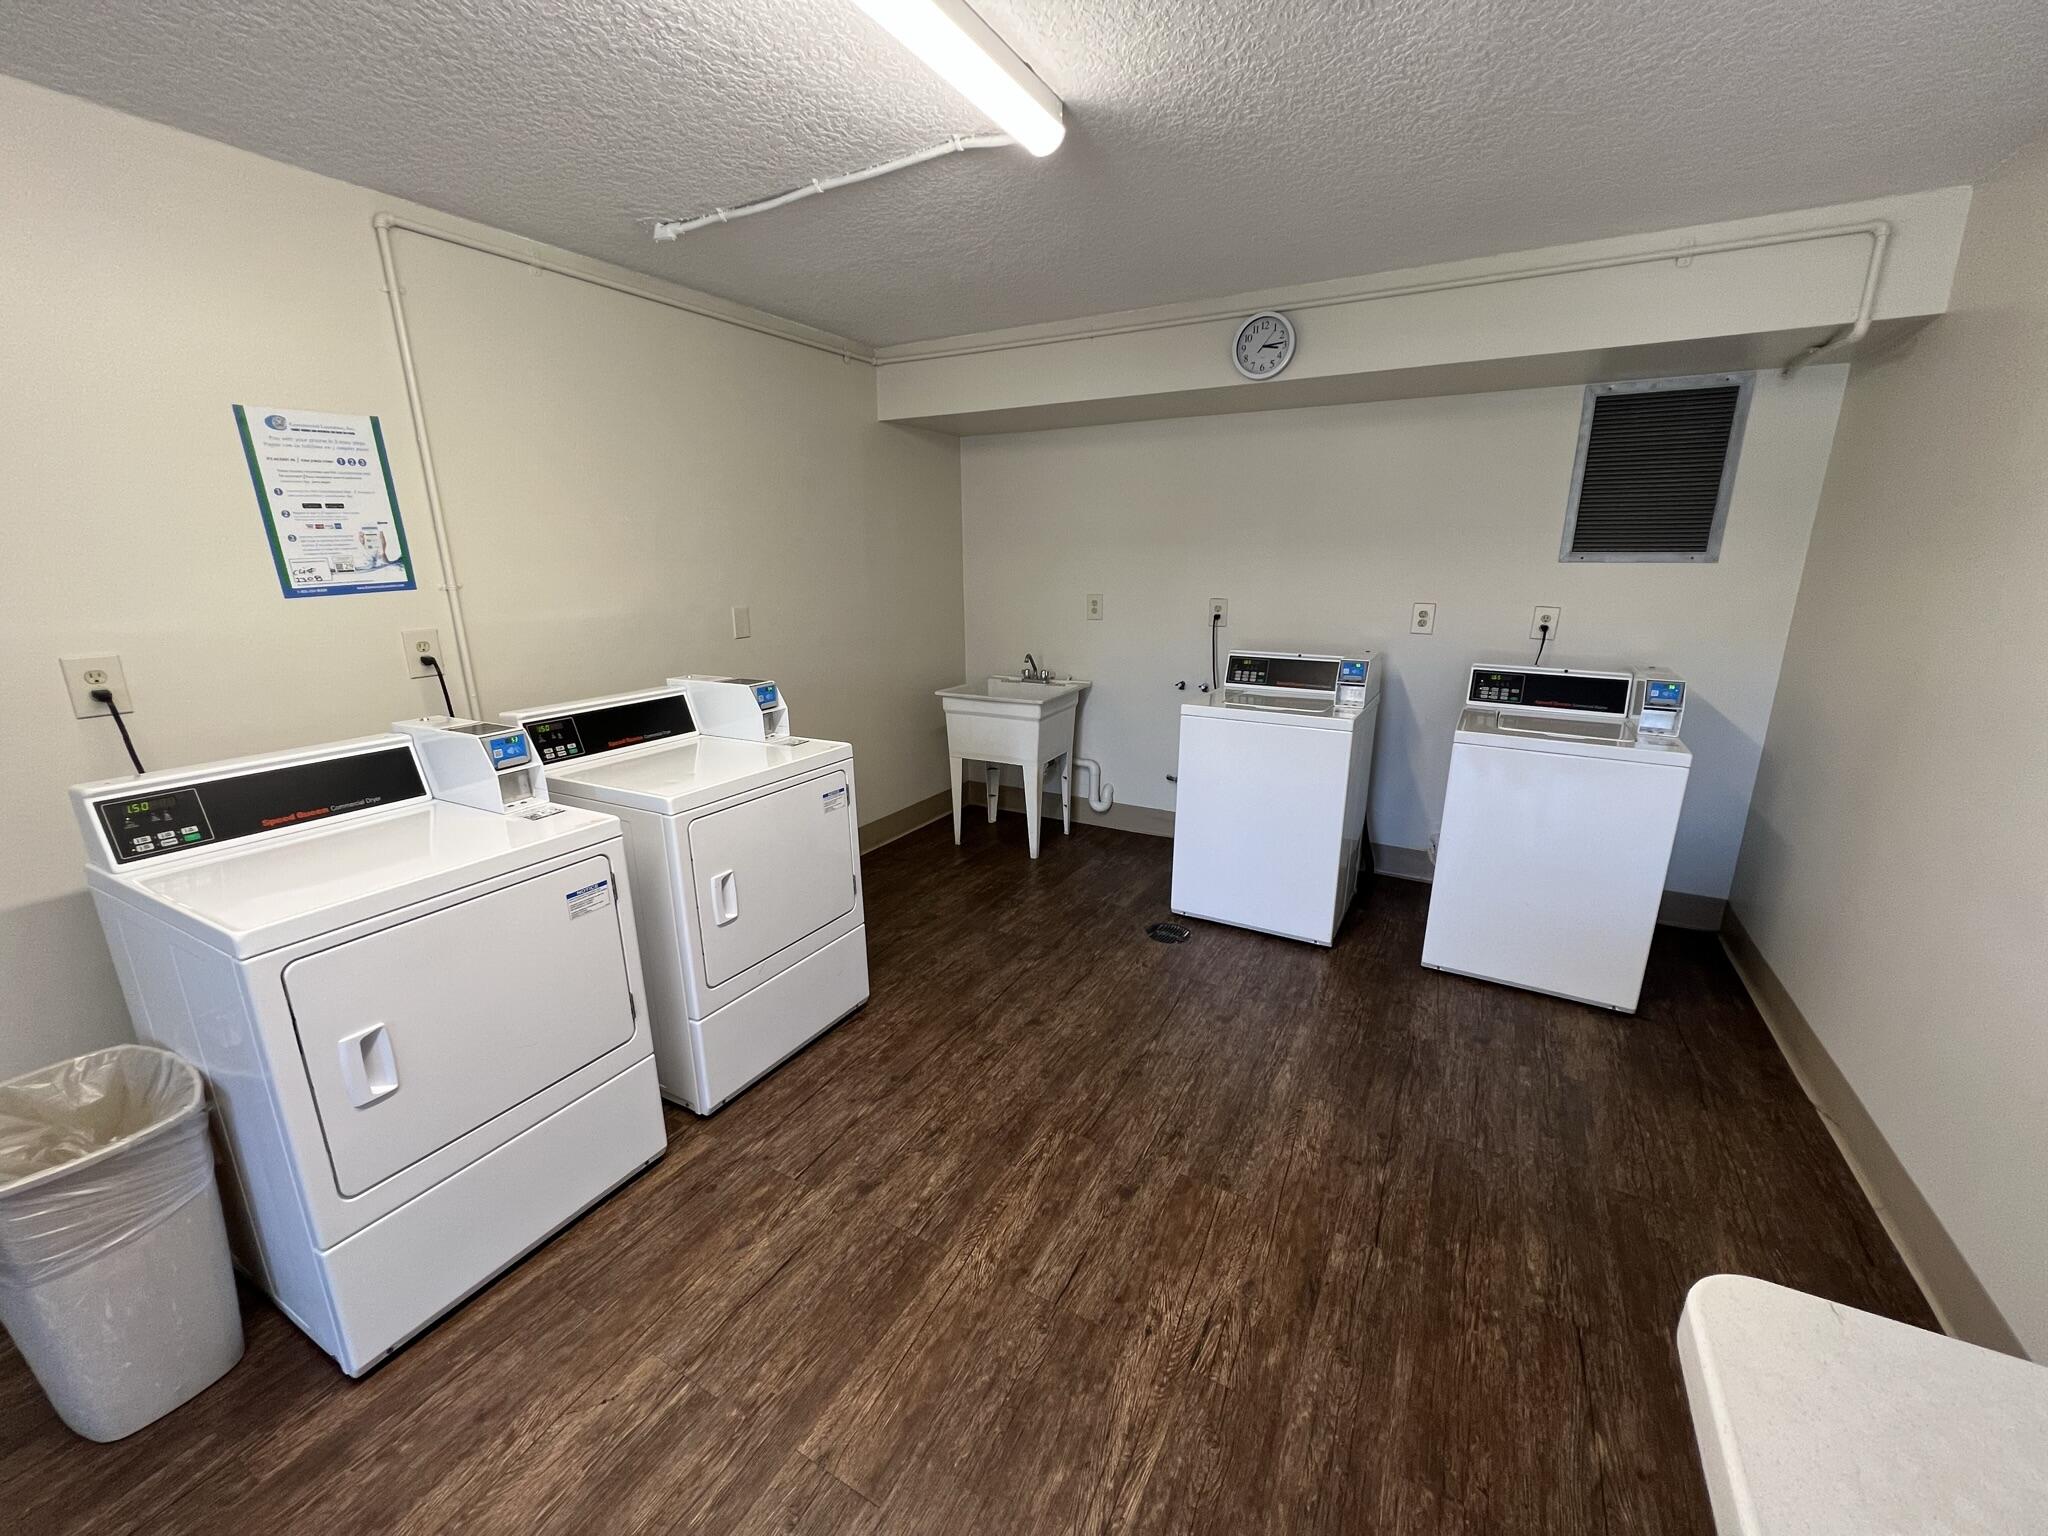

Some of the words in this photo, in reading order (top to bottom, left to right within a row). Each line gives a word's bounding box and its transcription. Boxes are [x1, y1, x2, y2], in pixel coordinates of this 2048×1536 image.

[1252, 325, 1259, 334] 11
[1261, 321, 1270, 330] 12
[1244, 334, 1253, 343] 10
[1279, 331, 1285, 339] 2
[1241, 344, 1247, 352] 9
[1243, 354, 1249, 363] 8
[1277, 351, 1282, 359] 4
[1250, 362, 1256, 370] 7
[1259, 364, 1265, 372] 6
[1269, 360, 1275, 368] 5
[261, 812, 296, 827] Speed
[296, 807, 329, 819] Queen
[330, 799, 365, 811] Commercial
[365, 796, 381, 805] Dryer
